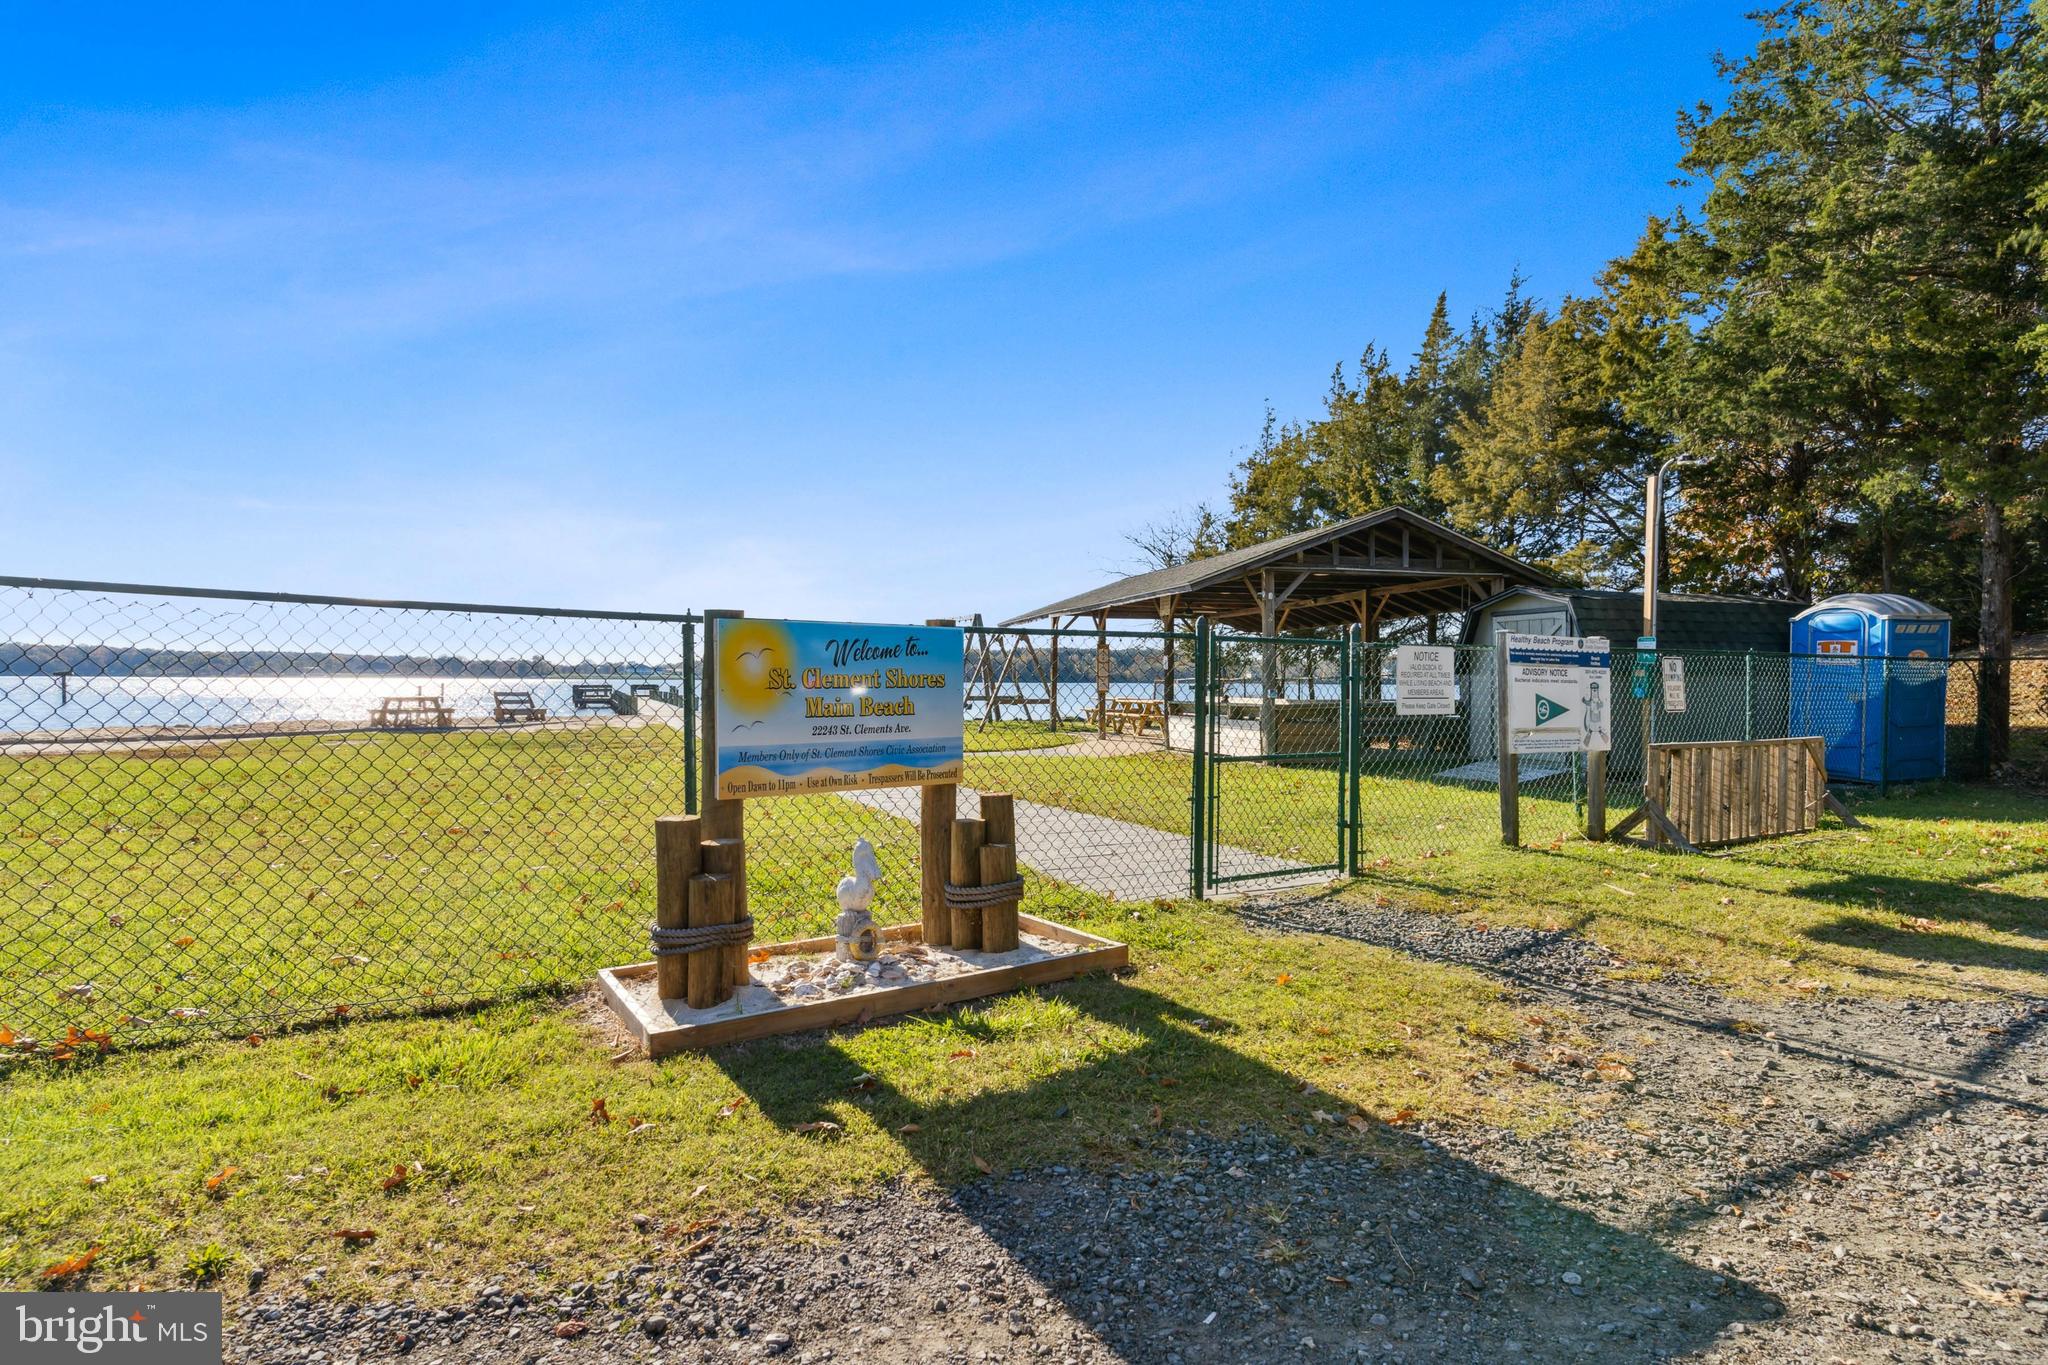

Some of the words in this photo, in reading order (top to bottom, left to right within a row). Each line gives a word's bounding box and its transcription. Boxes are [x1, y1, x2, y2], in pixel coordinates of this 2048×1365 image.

[1511, 635, 1531, 644] Healthy
[1533, 636, 1550, 644] Beach
[1552, 637, 1574, 646] Program
[825, 638, 902, 667] Welcome
[905, 635, 928, 657] to...
[1414, 651, 1439, 661] NOTICE
[1522, 668, 1547, 676] ADVISORY
[1550, 669, 1568, 677] NOTICE
[1669, 661, 1677, 672] NO
[768, 667, 796, 689] St.
[802, 667, 881, 689] Clement
[885, 667, 946, 689] Shores
[805, 696, 855, 718] Main
[859, 695, 915, 716] Beach
[812, 725, 838, 736] 22243
[840, 725, 851, 735] St.
[854, 724, 893, 735] Clements
[895, 724, 911, 733] Ave.
[738, 750, 777, 762] Members
[780, 749, 800, 762] Only
[801, 748, 811, 761] of
[811, 748, 822, 759] St.
[825, 747, 856, 759] Clement
[859, 746, 884, 756] Shores
[886, 745, 904, 755] Civic
[906, 743, 946, 754] Association
[728, 782, 746, 795] Open
[748, 781, 767, 792] Dawn
[769, 782, 775, 791] to
[778, 780, 796, 792] 11pm
[807, 777, 819, 788] Use
[820, 778, 827, 787] at
[829, 776, 842, 786] Own
[844, 774, 858, 785] Risk
[868, 773, 904, 785] Trespassers
[904, 770, 916, 782] Will
[917, 770, 925, 780] Be
[927, 768, 958, 779] Prosecuted
